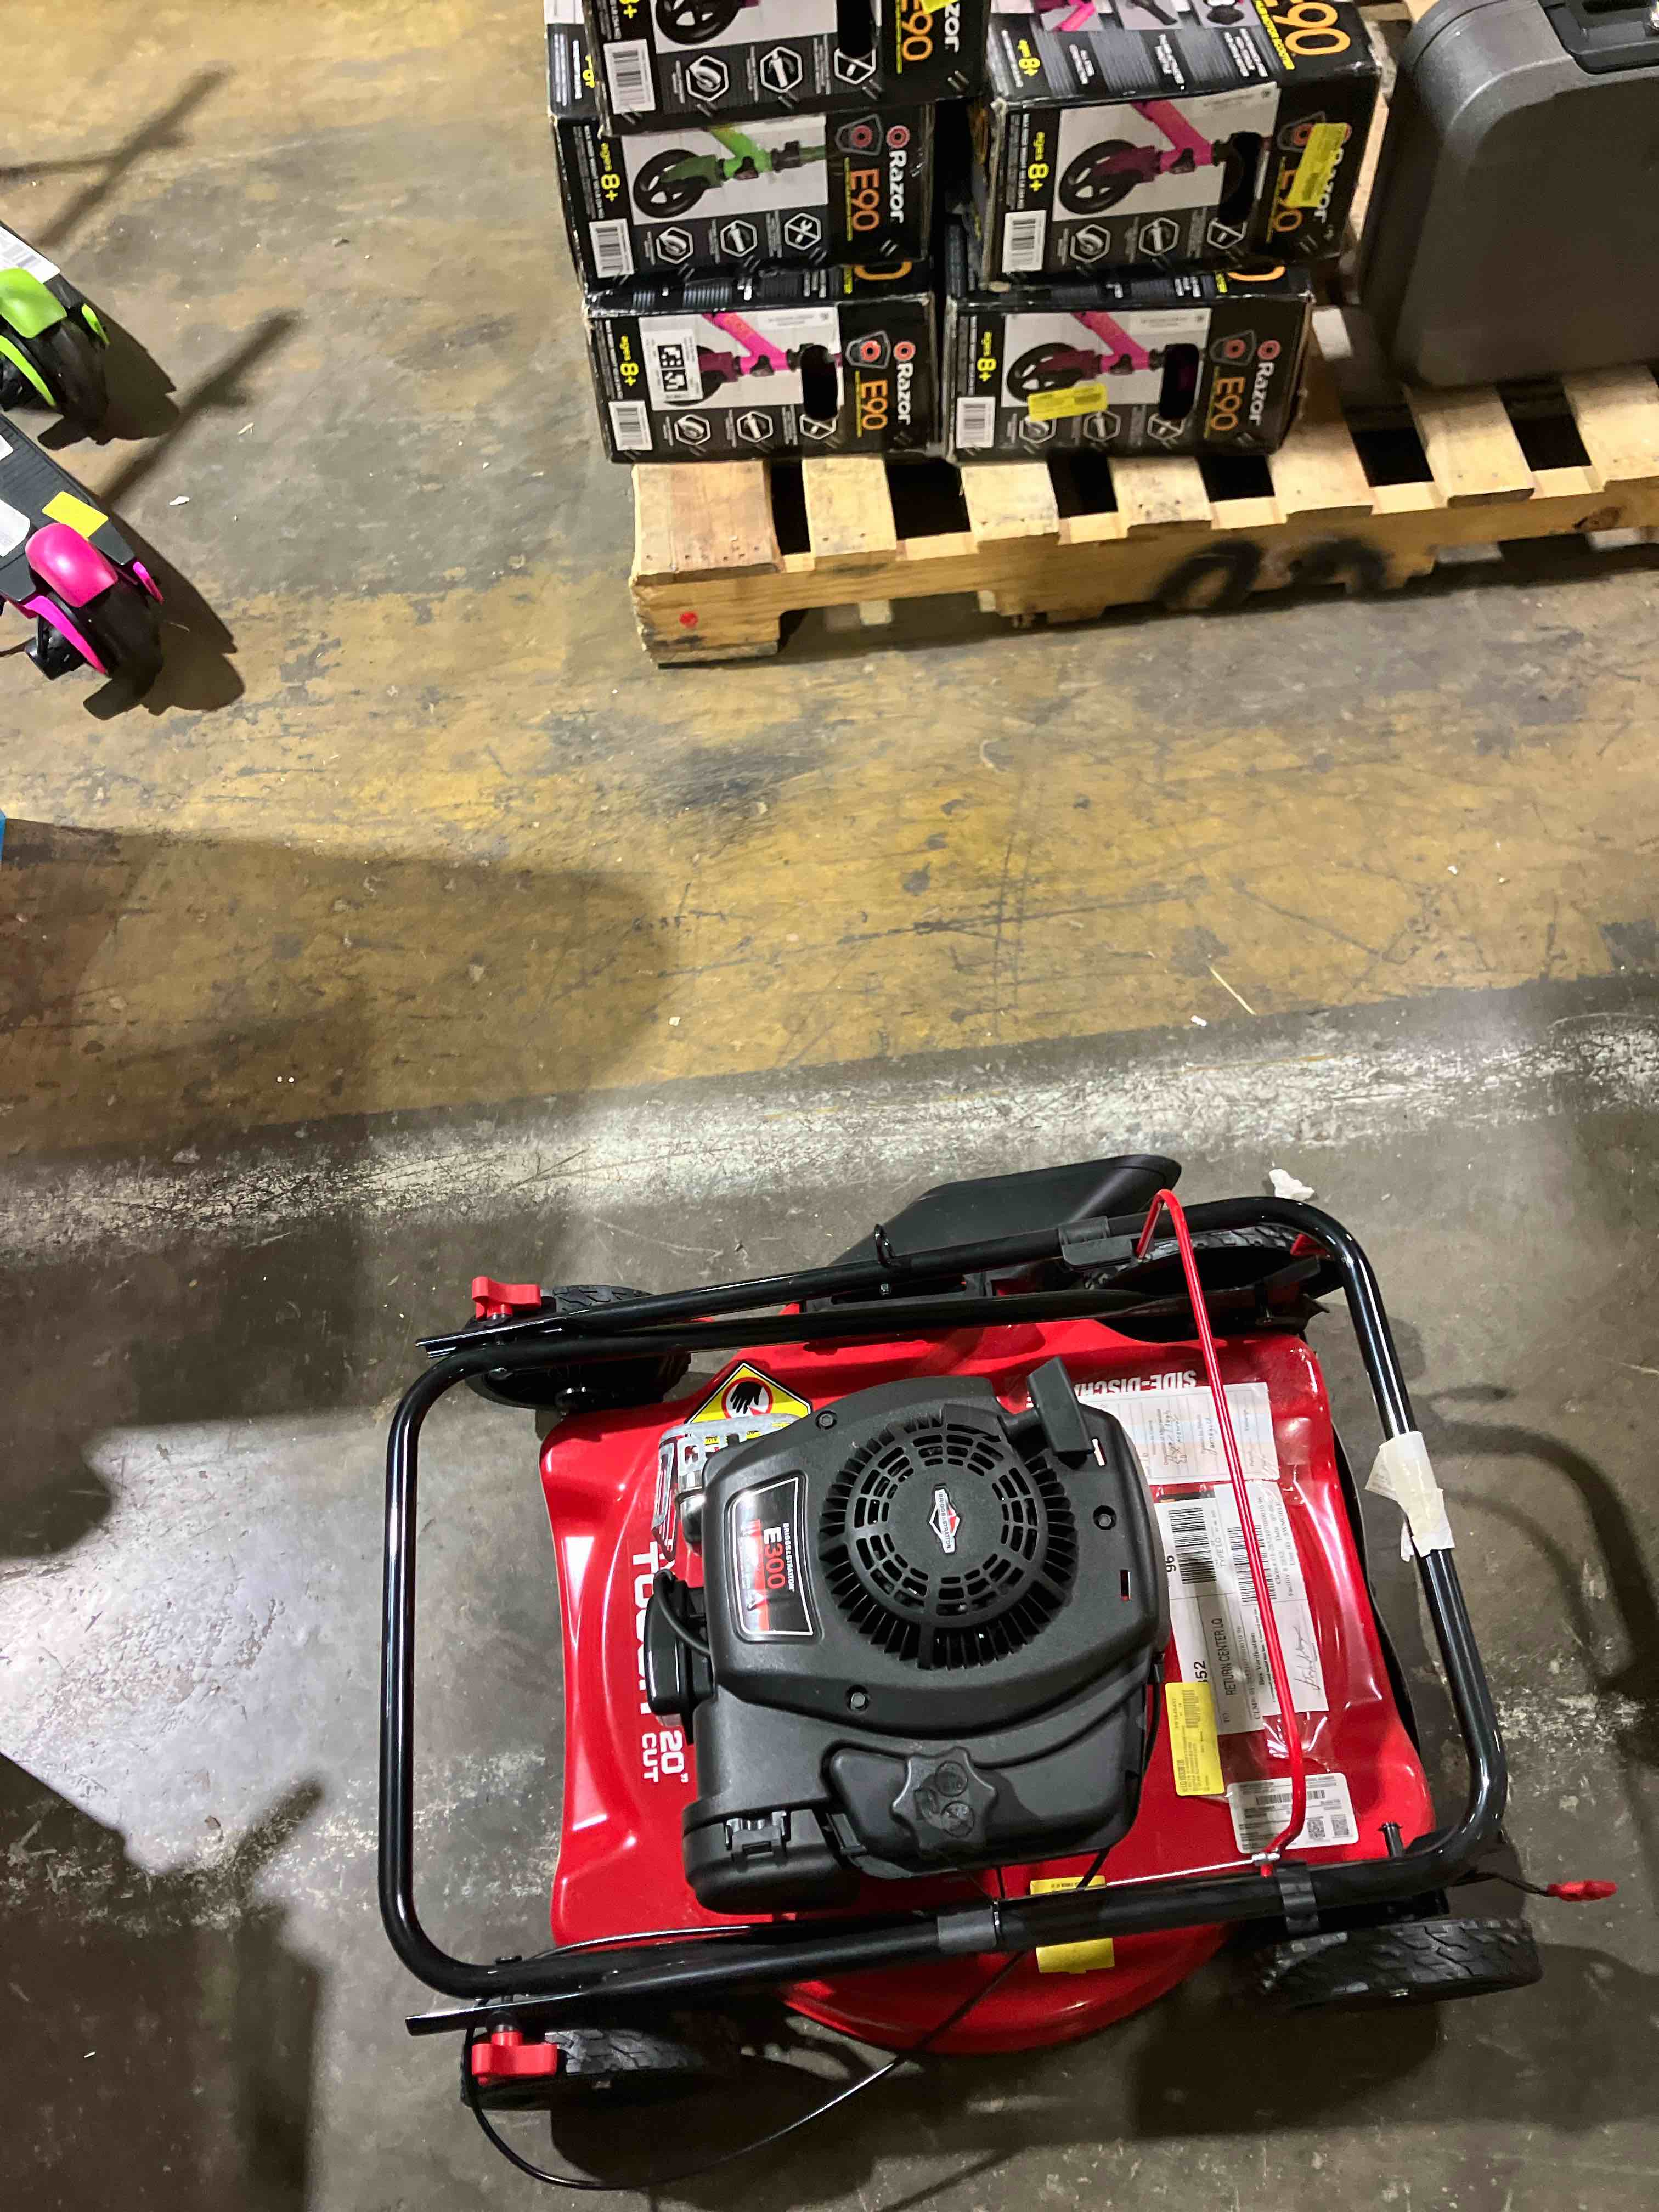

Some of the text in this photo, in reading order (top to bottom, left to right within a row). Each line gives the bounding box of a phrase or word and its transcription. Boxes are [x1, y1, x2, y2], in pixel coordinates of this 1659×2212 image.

[1018, 58, 1041, 76] 8+
[601, 173, 621, 202] 8+
[850, 168, 881, 231] E90
[889, 149, 907, 224] Razor
[1028, 163, 1049, 192] 8+
[620, 362, 639, 386] 8+
[896, 362, 913, 426] Razor
[977, 357, 997, 382] 8+
[1248, 362, 1275, 426] Razor
[860, 379, 888, 431] E90
[1210, 376, 1246, 431] E90
[763, 1526, 786, 1589] E300
[1165, 1555, 1176, 1573] 96
[1283, 1573, 1294, 1595] Facility
[1193, 1660, 1207, 1683] 52
[1211, 1618, 1238, 1696] RETURN CENTER LQ
[1248, 1632, 1261, 1671] Verification
[641, 1732, 659, 1783] CUT
[659, 1730, 689, 1783] 20"
